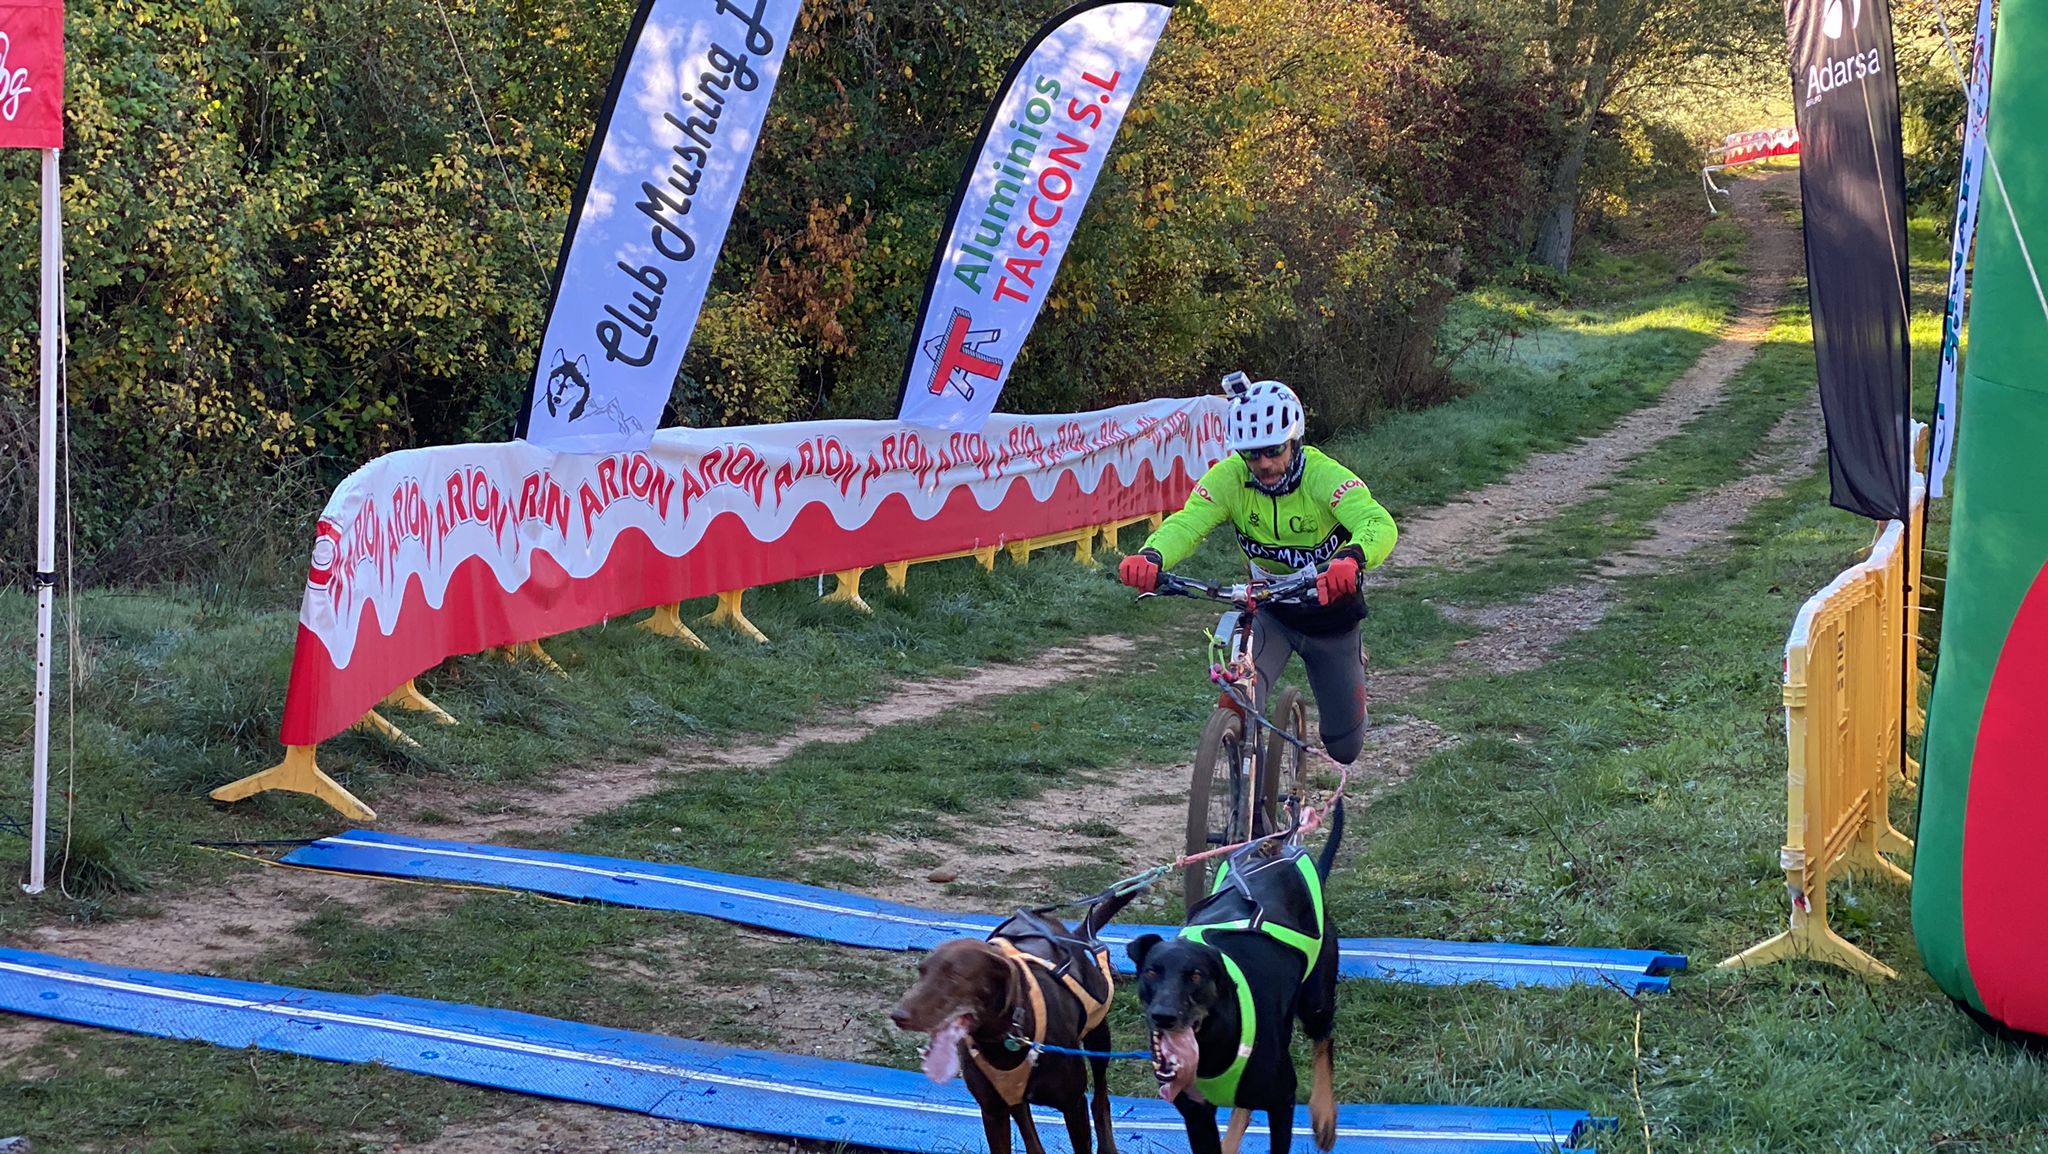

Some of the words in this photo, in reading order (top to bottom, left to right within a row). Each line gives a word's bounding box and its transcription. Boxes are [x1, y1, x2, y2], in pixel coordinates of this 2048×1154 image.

[1807, 48, 1880, 98] Adarsa
[596, 261, 667, 367] Club
[635, 42, 759, 262] Mushing
[953, 74, 1061, 295] Aluminios
[992, 131, 1090, 303] TASCON
[435, 468, 508, 568] ARION
[577, 452, 676, 543] ARION
[682, 444, 769, 524] ARION
[774, 436, 862, 509] ARION
[861, 431, 934, 499] ARION
[934, 431, 995, 488] ARION
